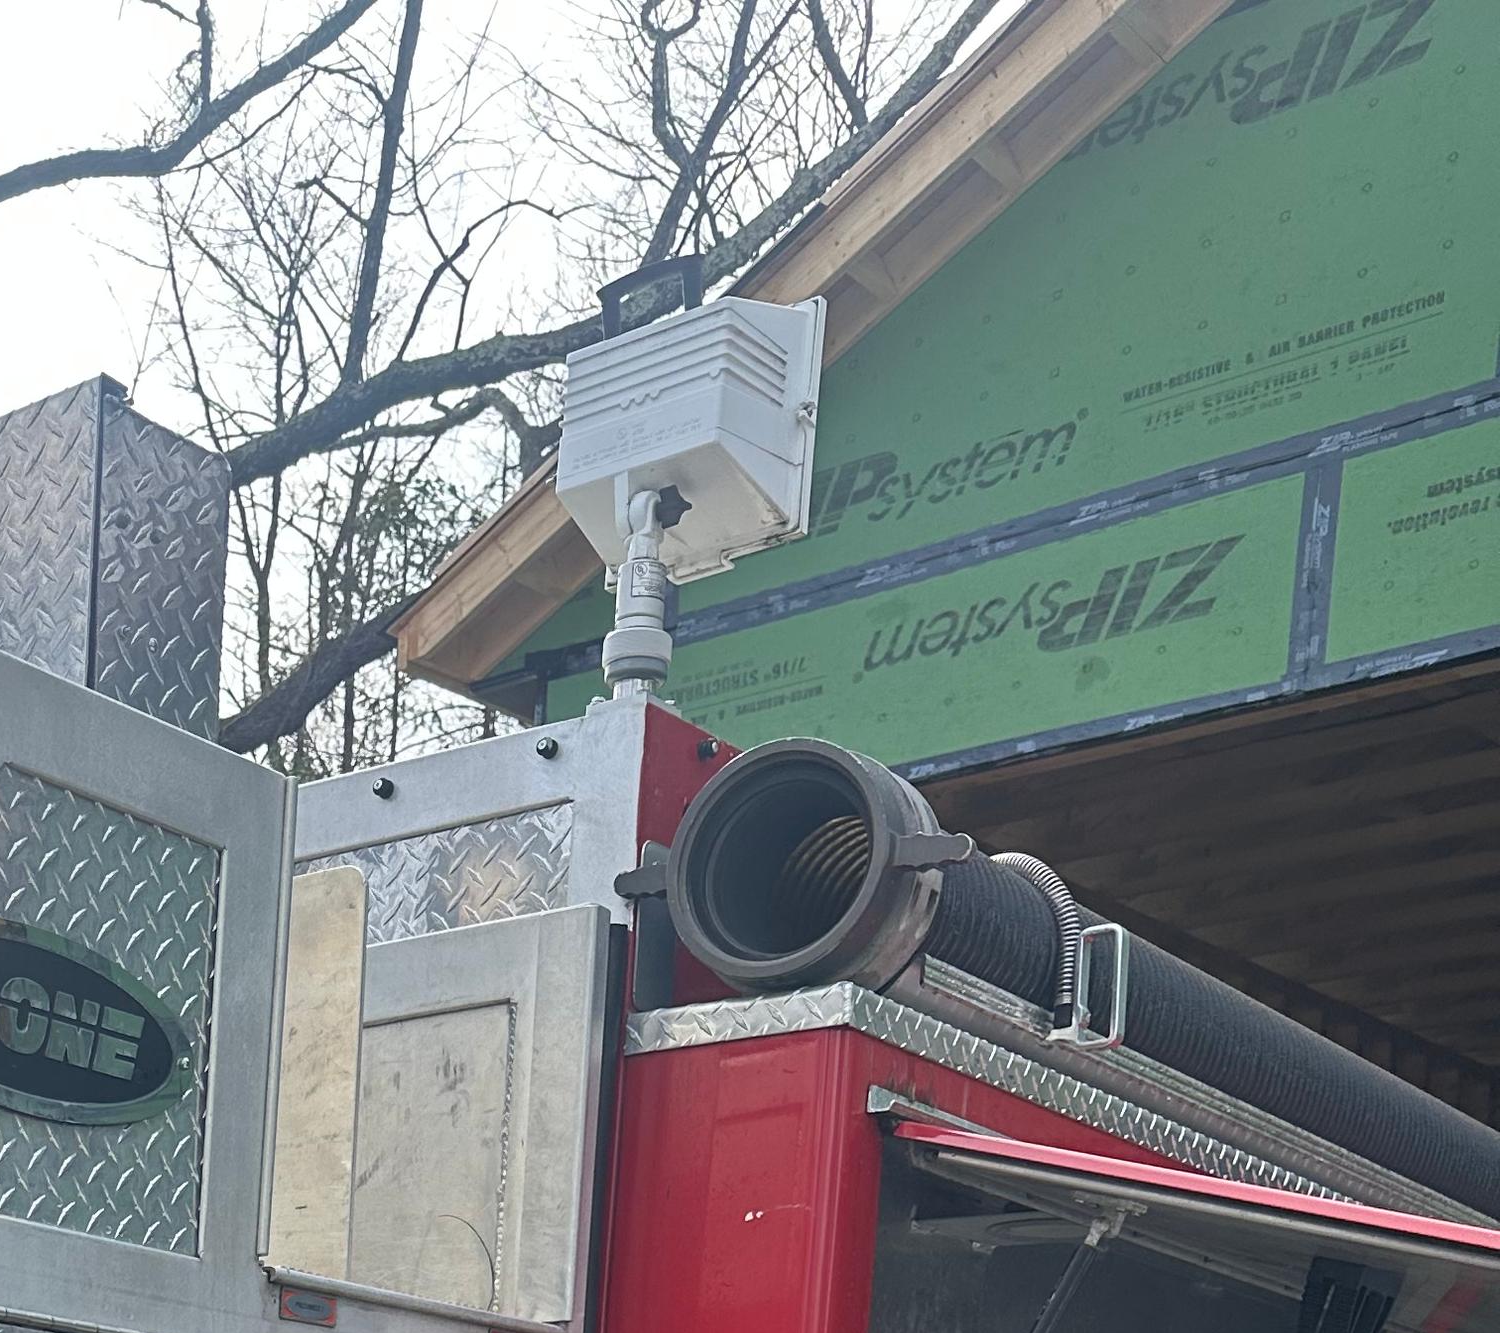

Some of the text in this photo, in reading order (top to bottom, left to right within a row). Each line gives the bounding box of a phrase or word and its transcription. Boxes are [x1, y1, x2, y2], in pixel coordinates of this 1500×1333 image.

[1267, 339, 1291, 358] AIR
[1297, 319, 1355, 349] BARRIER
[1362, 289, 1446, 330] PROTECTION
